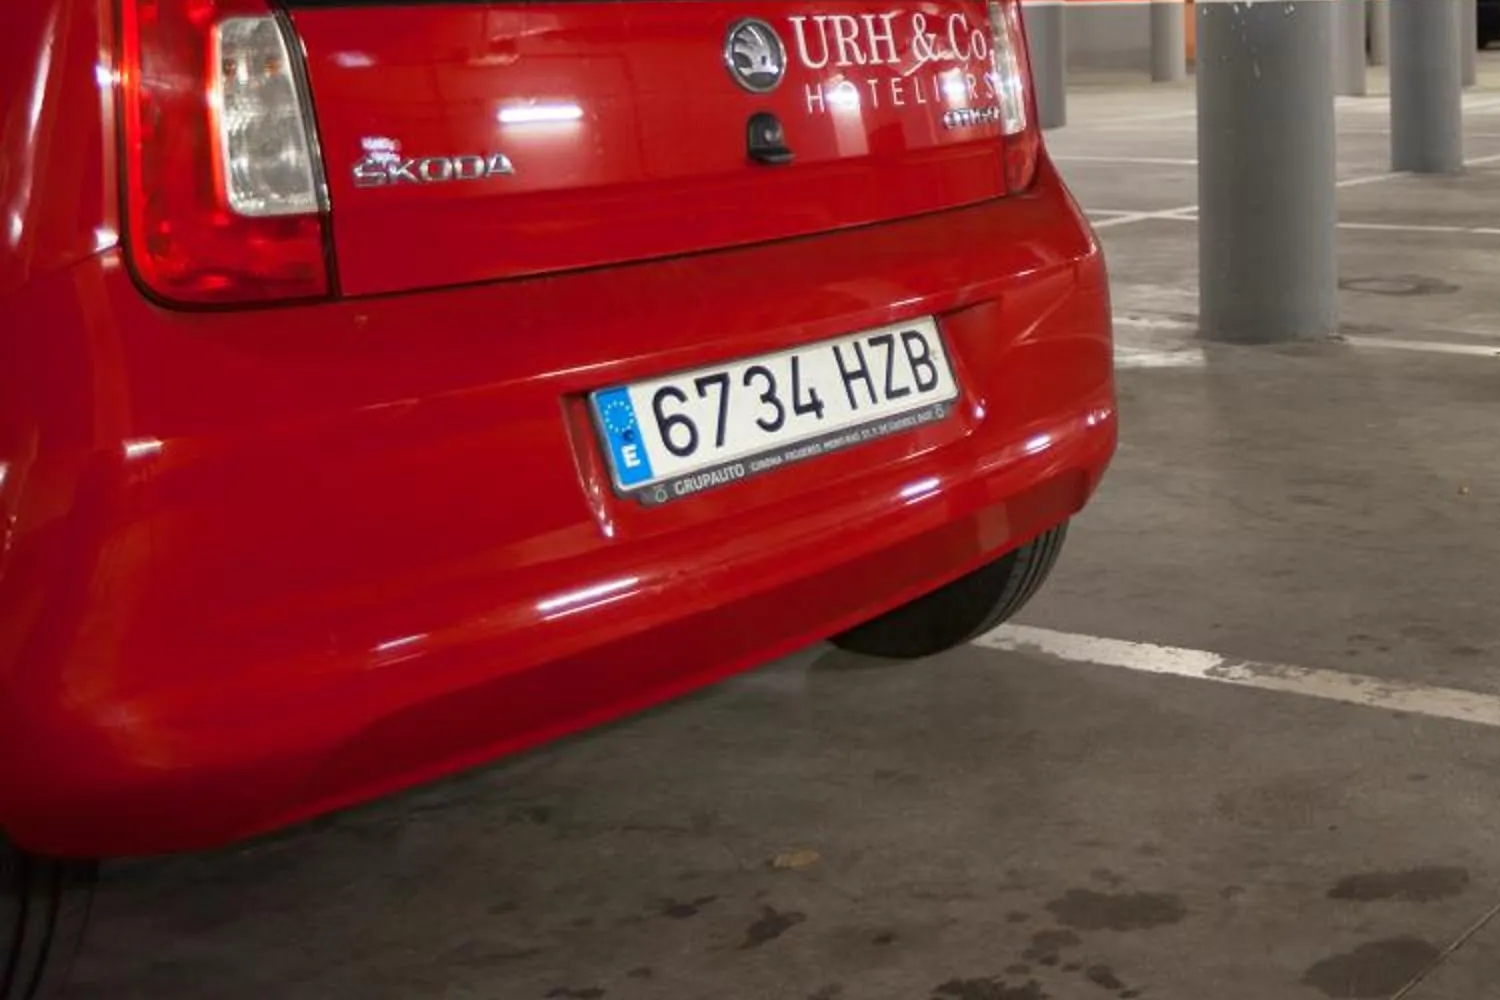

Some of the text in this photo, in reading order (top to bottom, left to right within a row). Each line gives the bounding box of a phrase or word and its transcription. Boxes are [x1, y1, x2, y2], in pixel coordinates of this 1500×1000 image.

[788, 11, 901, 69] URH
[911, 12, 941, 62] &
[806, 72, 998, 114] HOTELIRS
[621, 443, 641, 468] E
[652, 355, 824, 457] 6734
[832, 329, 939, 411] HZB
[673, 463, 745, 495] GRUPAUTO
